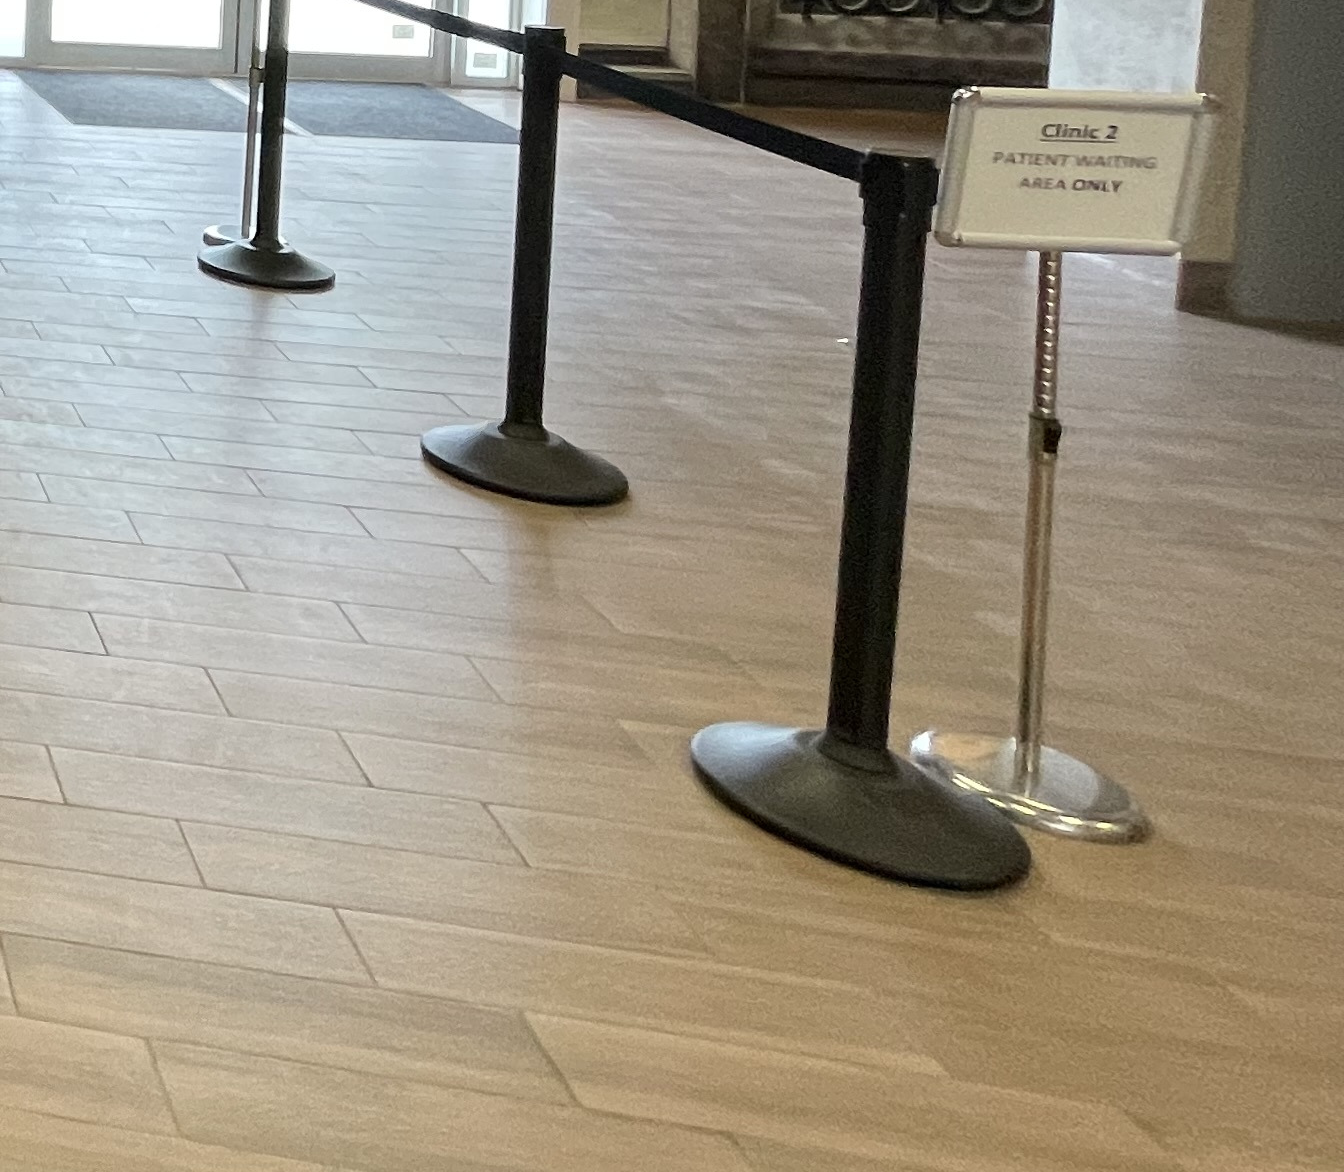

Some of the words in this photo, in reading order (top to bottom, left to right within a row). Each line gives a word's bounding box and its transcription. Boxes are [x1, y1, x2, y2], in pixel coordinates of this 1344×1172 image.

[1041, 123, 1098, 139] Clinic
[1105, 125, 1118, 140] 2
[992, 152, 1069, 167] PATIENT
[1074, 155, 1157, 169] WAITING
[1019, 178, 1066, 191] AREA
[1072, 179, 1124, 192] ONLY
